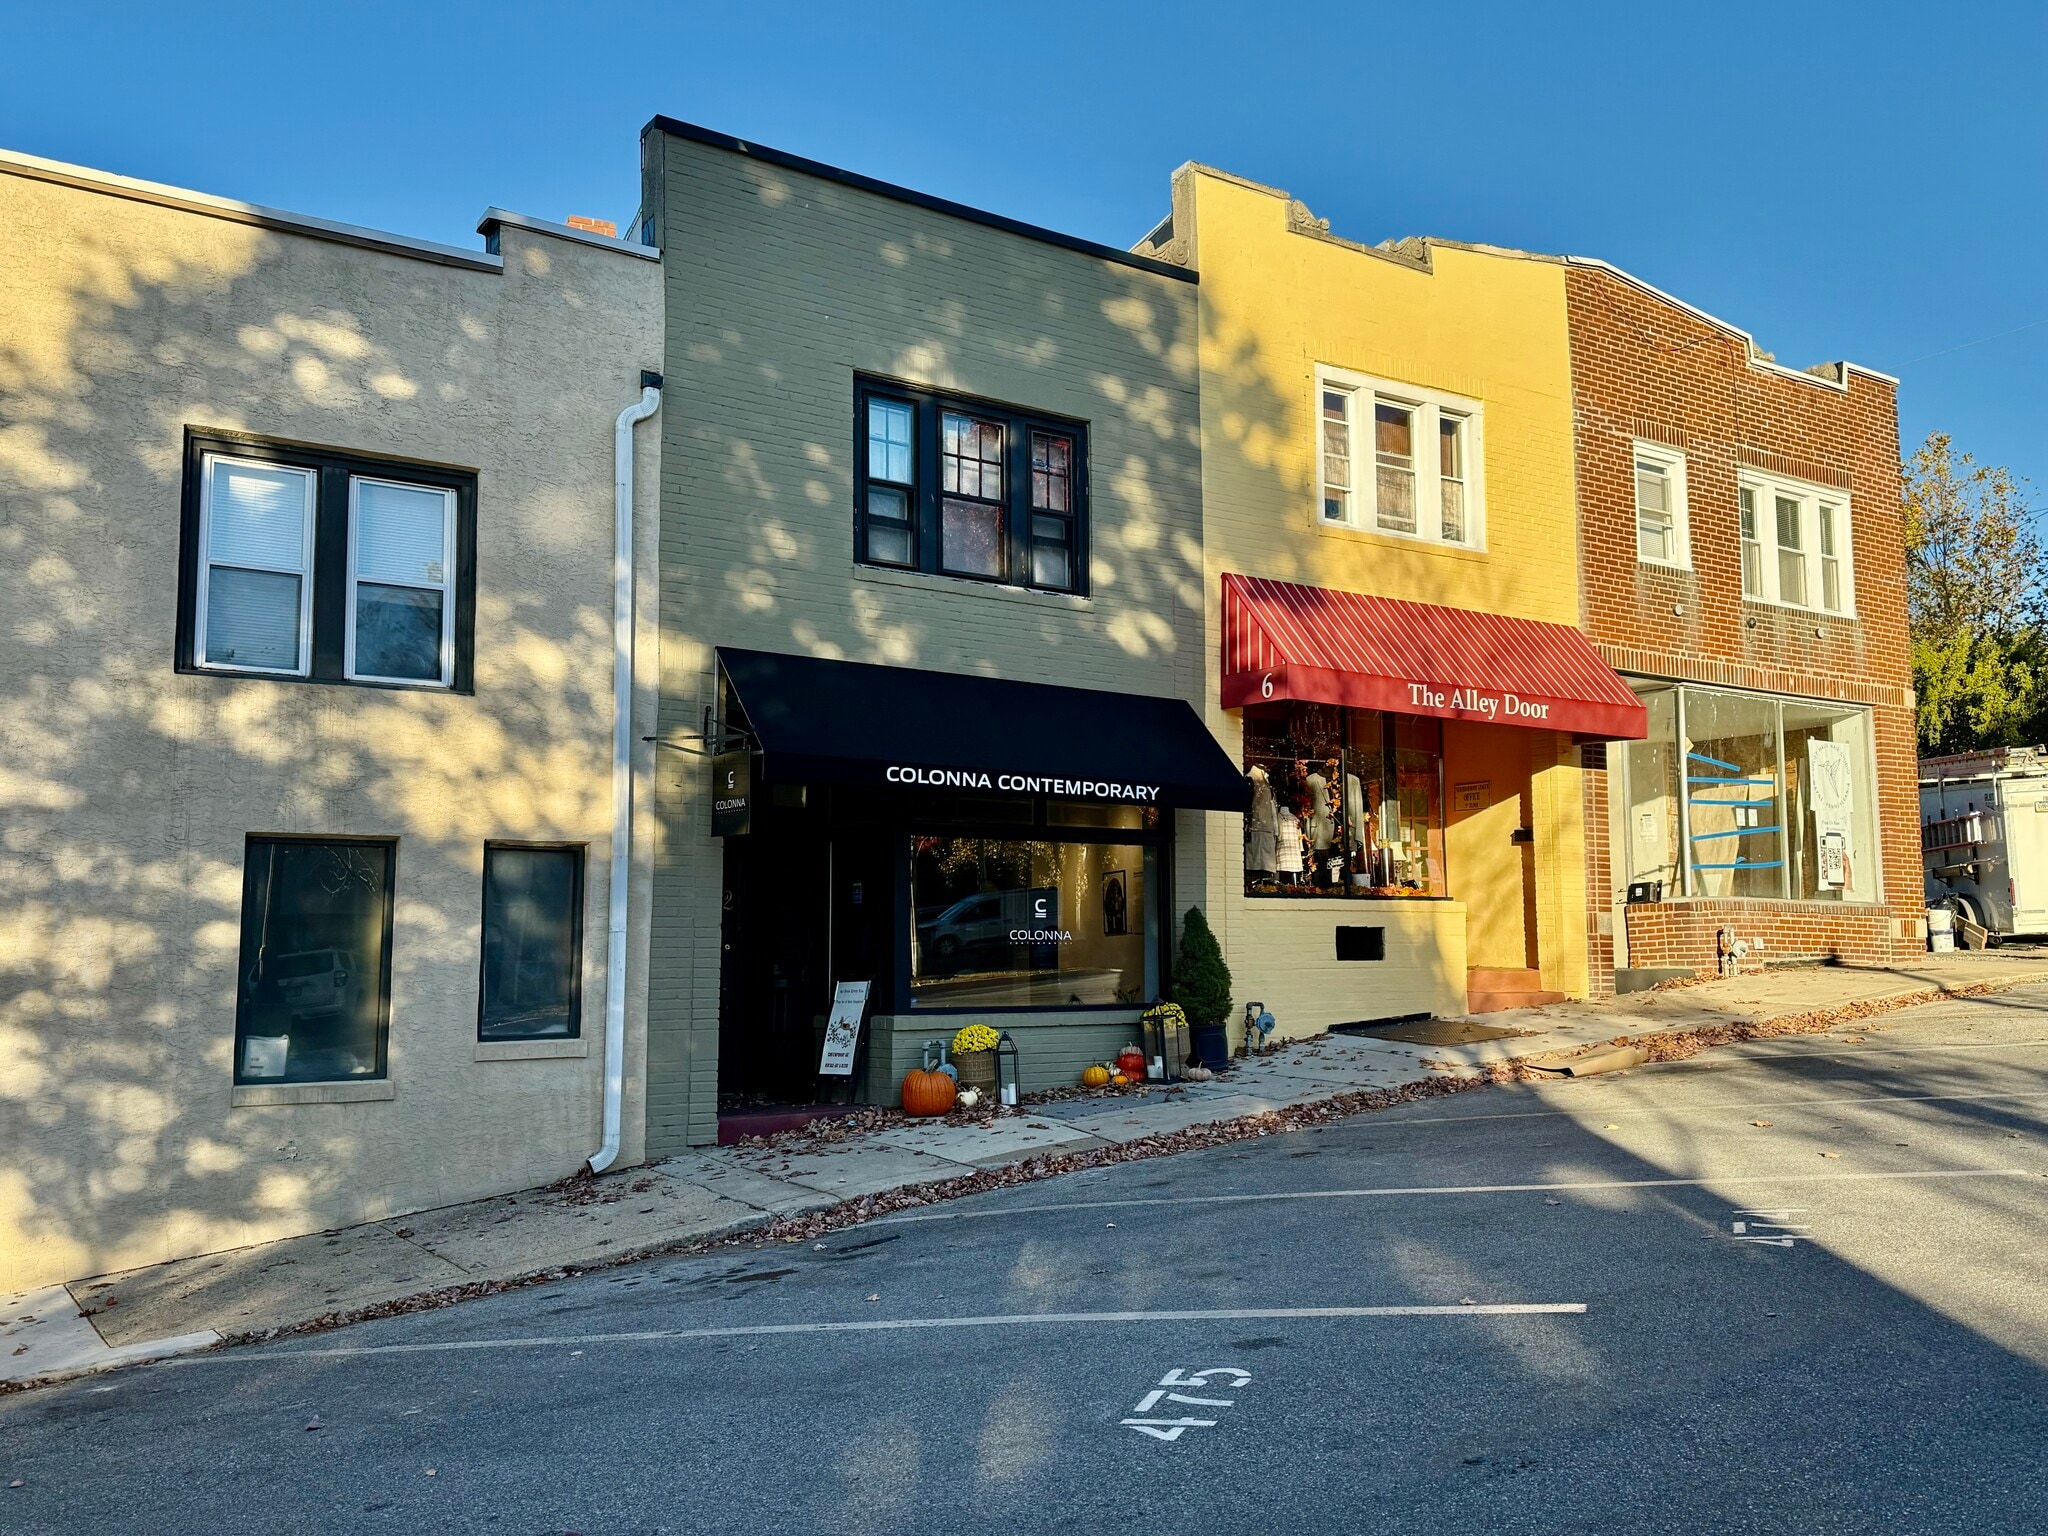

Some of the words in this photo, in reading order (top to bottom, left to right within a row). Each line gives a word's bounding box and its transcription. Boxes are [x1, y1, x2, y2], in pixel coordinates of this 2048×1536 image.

[1261, 672, 1274, 699] 6
[1407, 682, 1445, 708] The
[1449, 688, 1500, 720] Alley
[1503, 693, 1550, 719] Door
[886, 766, 993, 789] COLONNA
[997, 774, 1161, 801] CONTEMPORARY
[715, 797, 747, 811] COLONNA
[1463, 792, 1481, 801] OFFICE
[723, 890, 735, 911] 2
[1009, 929, 1073, 941] COLONNA
[1119, 1367, 1252, 1441] 475
